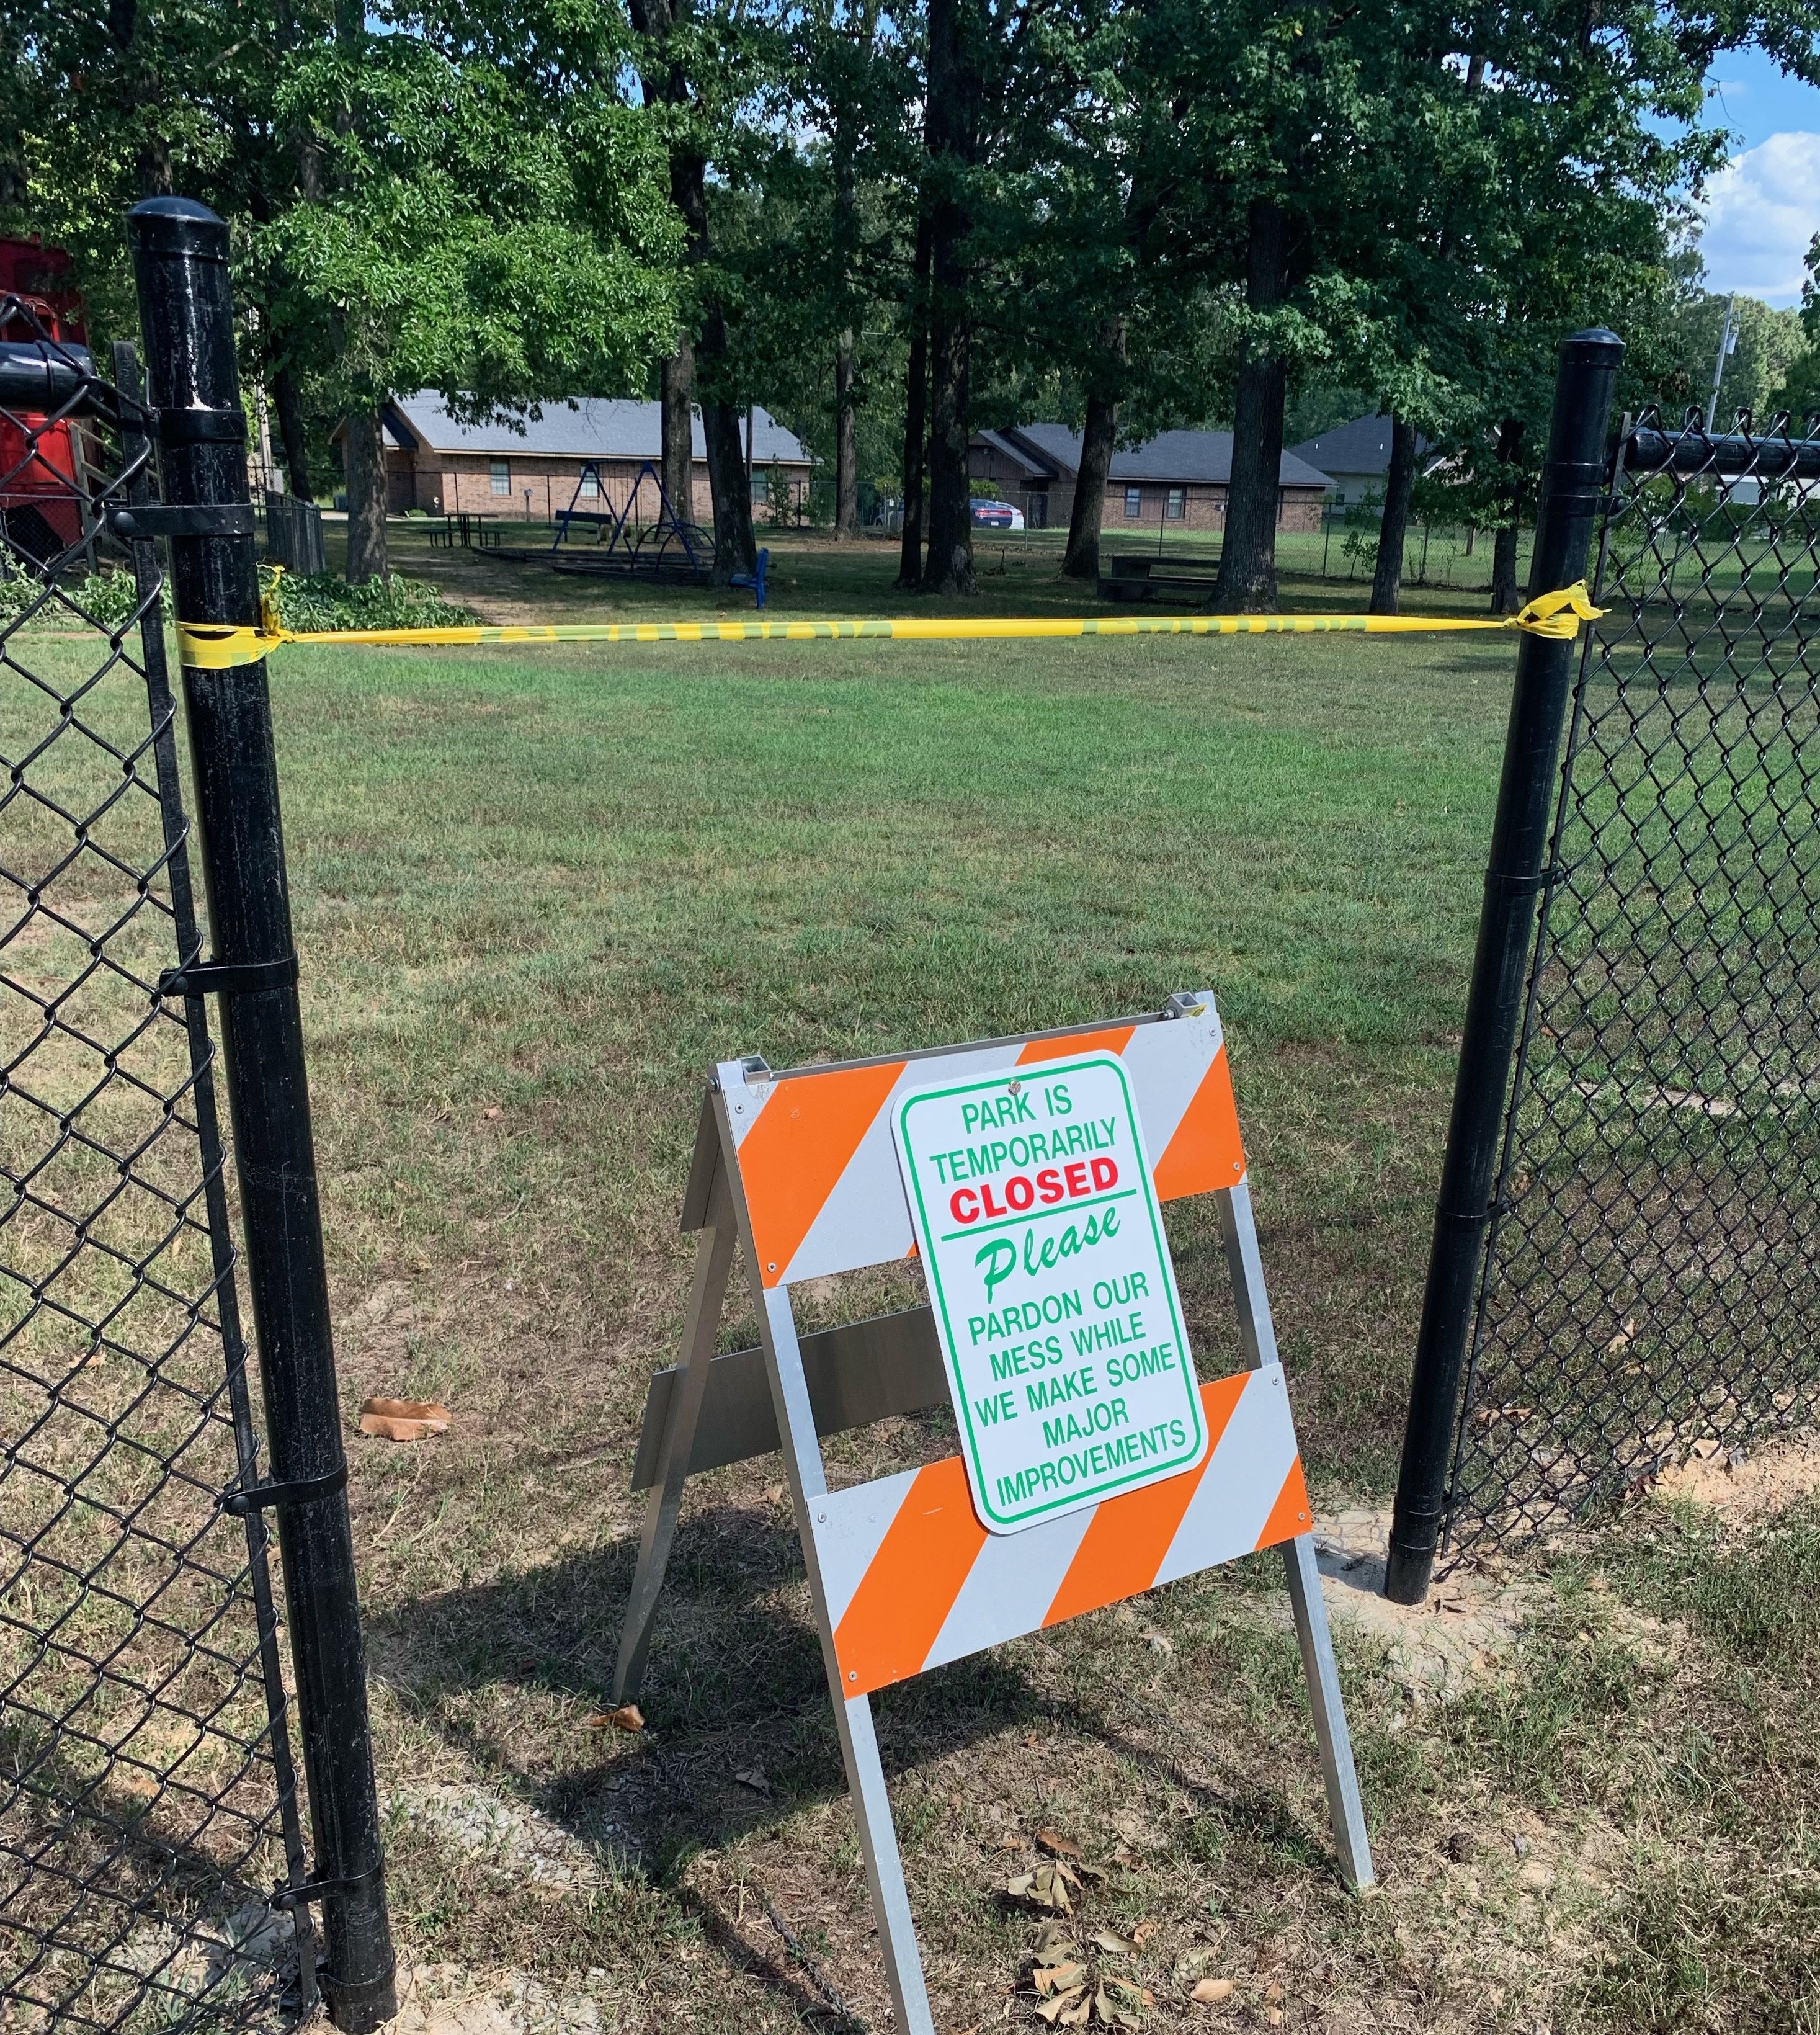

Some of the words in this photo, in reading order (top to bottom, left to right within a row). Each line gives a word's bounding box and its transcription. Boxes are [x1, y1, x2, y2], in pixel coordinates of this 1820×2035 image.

[961, 1091, 1036, 1134] PARK
[1045, 1085, 1073, 1118] IS
[930, 1117, 1117, 1185] TEMPORARILY
[950, 1157, 1118, 1224] CLOSED
[975, 1207, 1121, 1304] Please
[968, 1289, 1083, 1346] PARDON
[1093, 1272, 1149, 1310] OUR
[989, 1335, 1063, 1382] MESS
[1071, 1312, 1146, 1356] WHILE
[974, 1390, 1019, 1428] WE
[1028, 1366, 1098, 1414] MAKE
[1107, 1342, 1176, 1387] SOME
[1043, 1397, 1130, 1449] MAJOR
[996, 1419, 1186, 1507] IMPROVEMENTS
